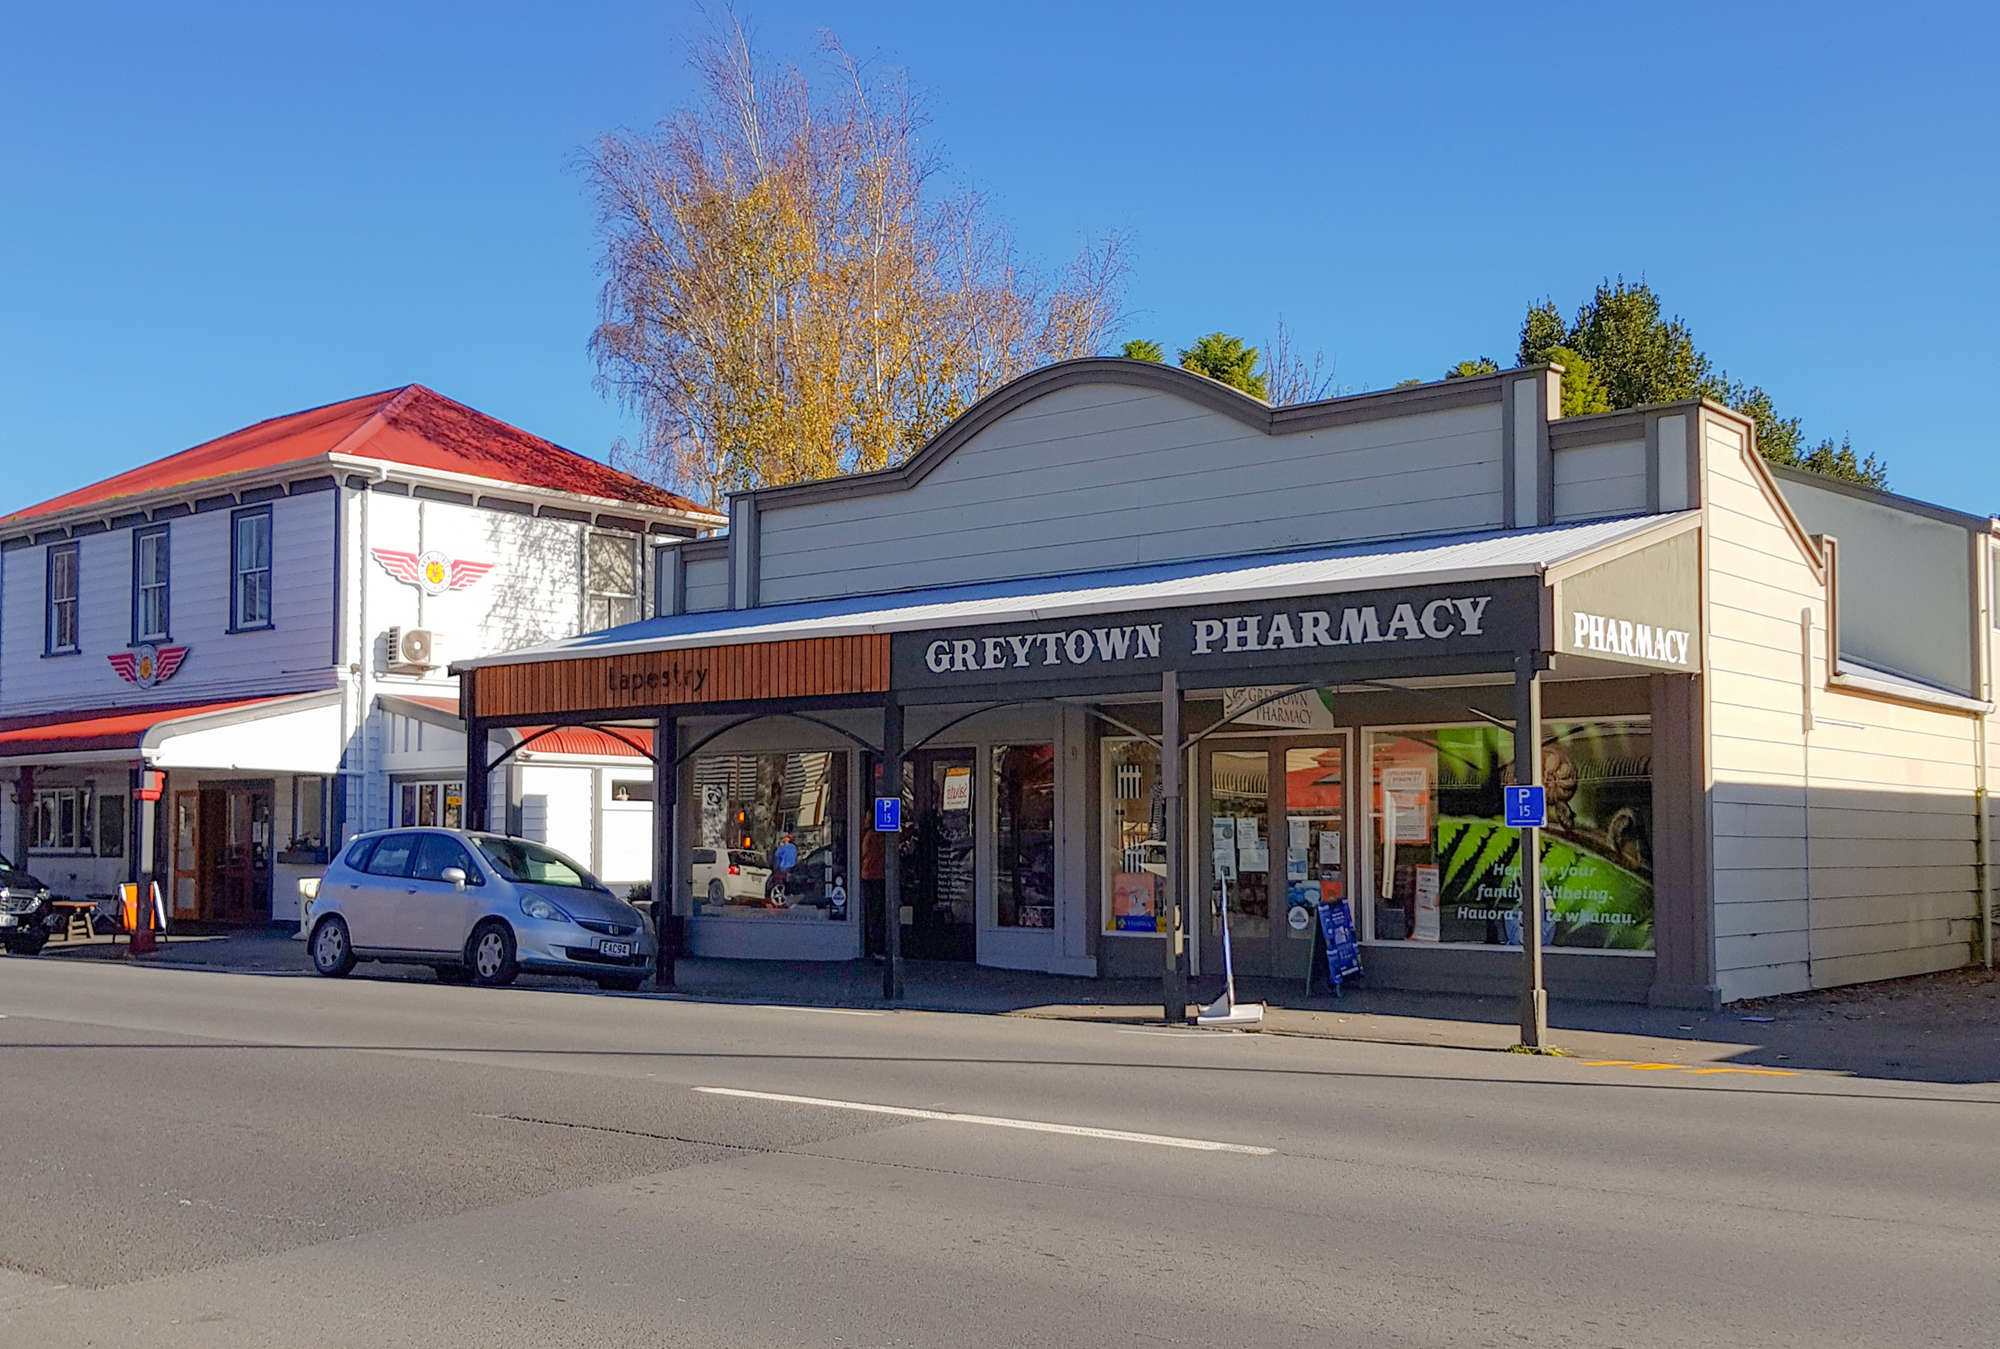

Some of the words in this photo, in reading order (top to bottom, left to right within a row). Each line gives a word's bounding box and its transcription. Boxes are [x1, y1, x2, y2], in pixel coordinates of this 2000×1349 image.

[925, 623, 1163, 674] GREYTOWN
[1191, 596, 1492, 655] PHARMACY
[1572, 611, 1690, 665] PHARMACY
[609, 661, 708, 702] tapestry
[1518, 788, 1531, 804] P
[883, 799, 892, 812] P
[1519, 804, 1531, 817] 15
[883, 812, 892, 823] 15
[1558, 866, 1597, 881] your
[1476, 883, 1523, 904] family
[1541, 885, 1614, 904] ellbeing.
[1457, 907, 1514, 921] Hauora
